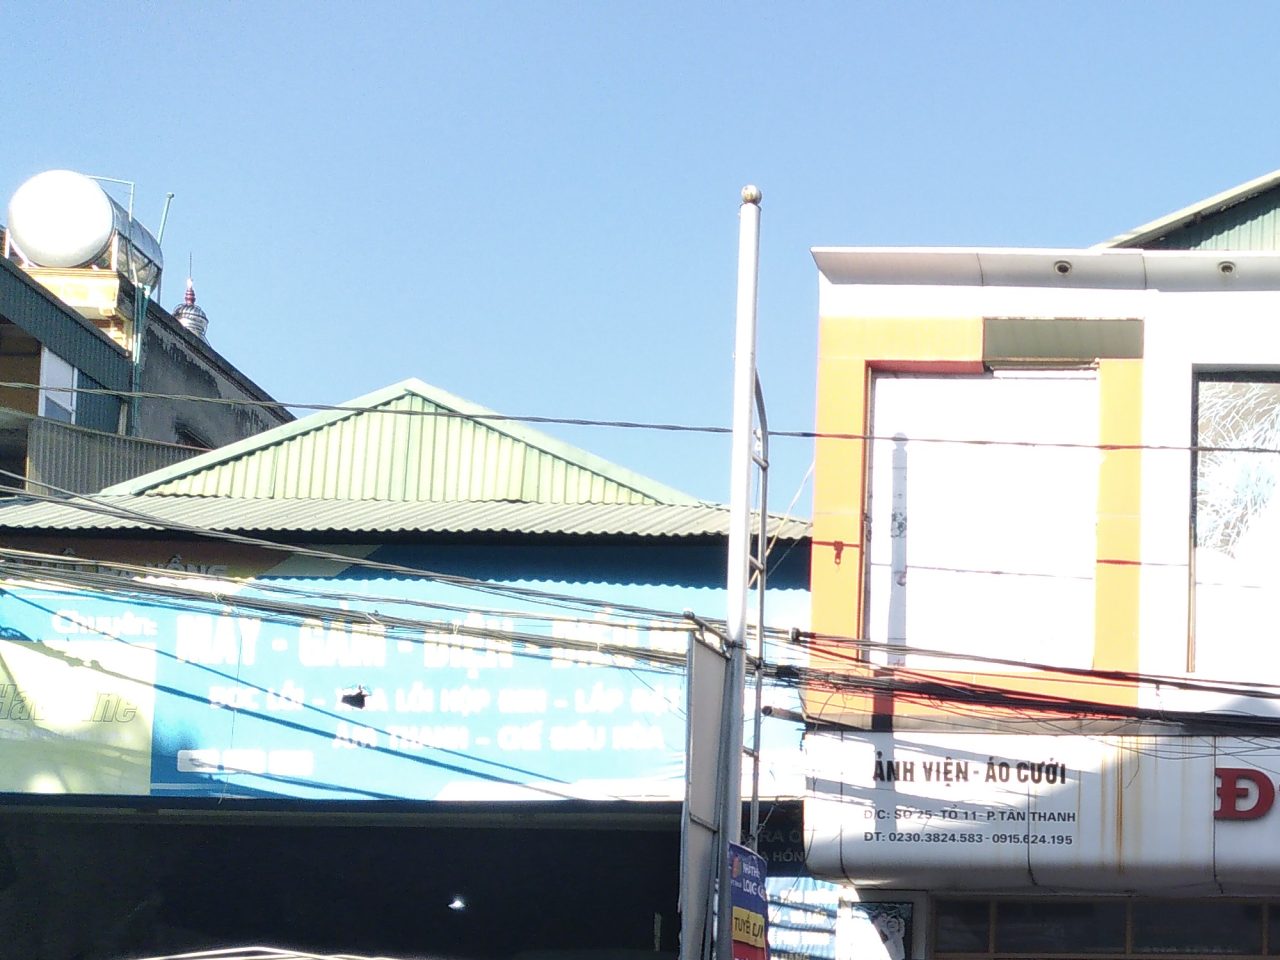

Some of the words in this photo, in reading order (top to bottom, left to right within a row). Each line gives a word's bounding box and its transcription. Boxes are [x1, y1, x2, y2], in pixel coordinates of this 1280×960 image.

[873, 751, 914, 782] ẢNH
[985, 757, 1010, 783] ÁO
[1029, 812, 1076, 823] THANH
[888, 831, 983, 843] 0230.3824.583
